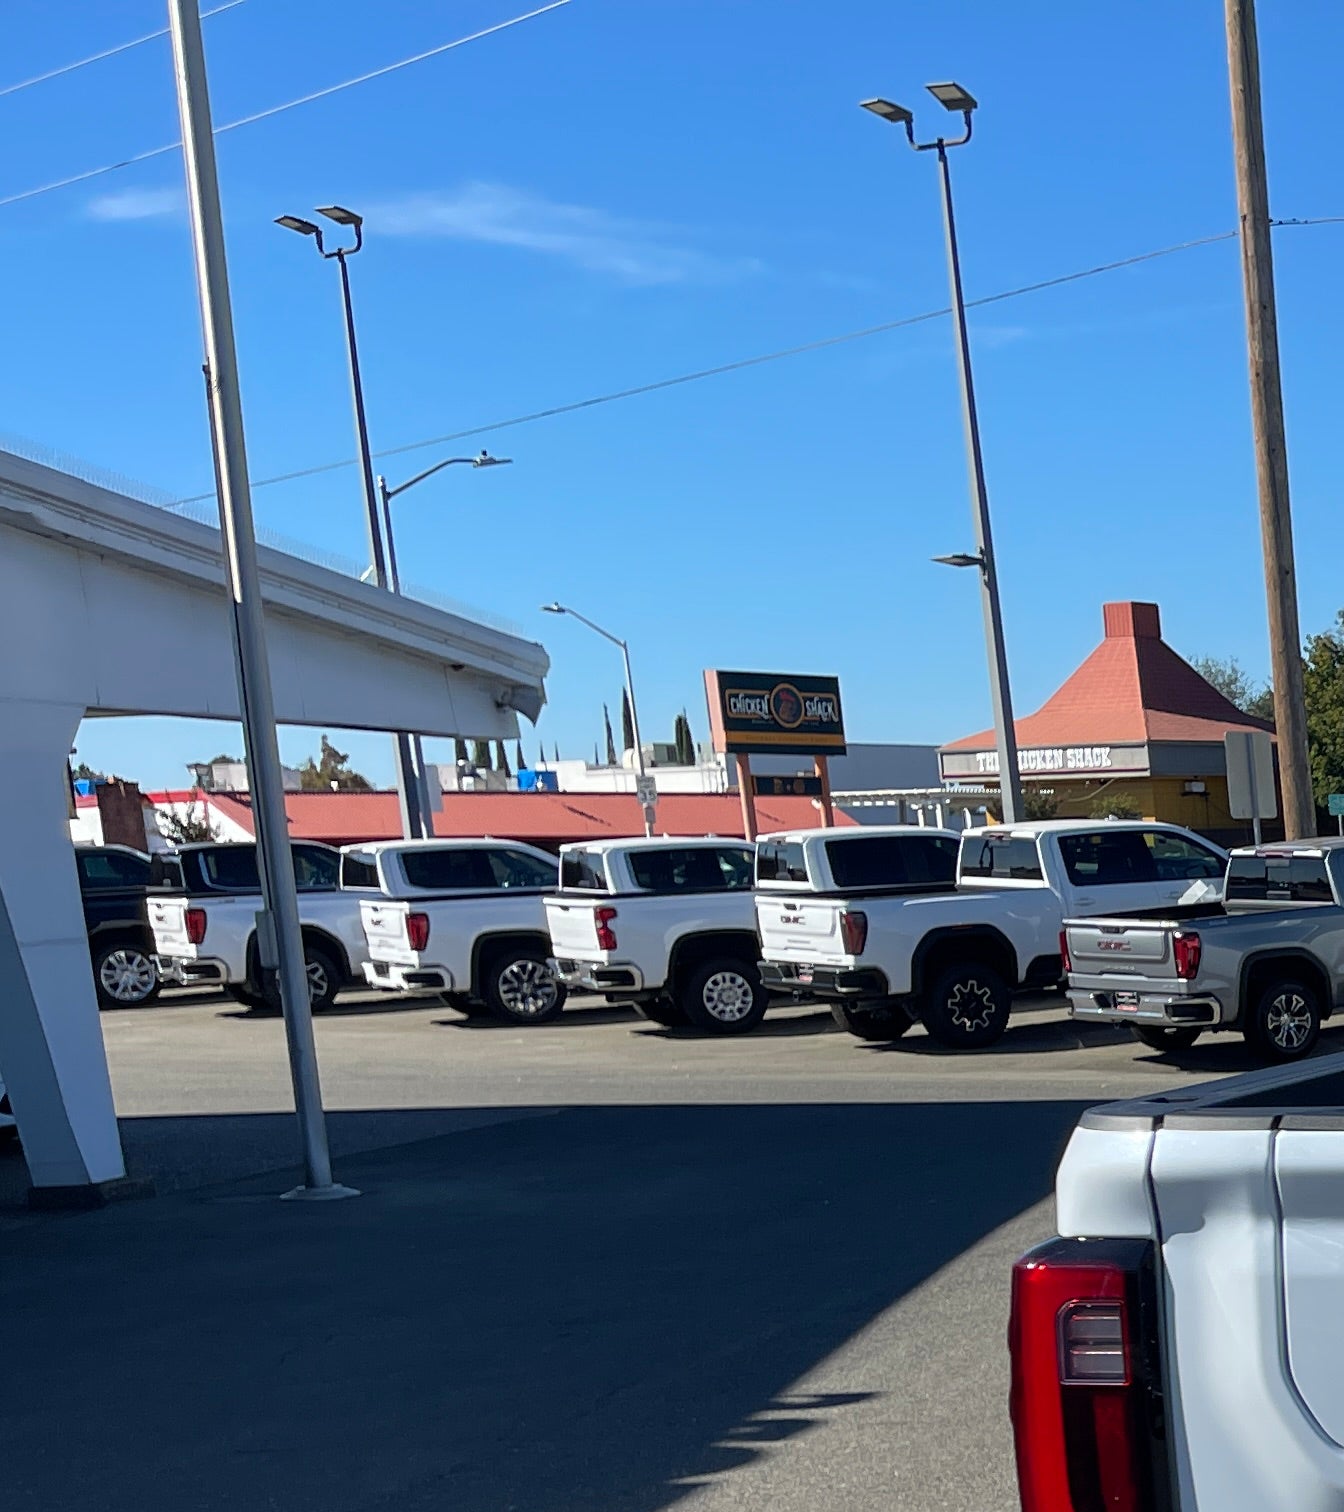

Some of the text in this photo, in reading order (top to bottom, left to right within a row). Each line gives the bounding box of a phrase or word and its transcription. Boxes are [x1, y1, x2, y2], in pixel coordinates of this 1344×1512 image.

[730, 693, 839, 722] CHICKEN SHACK
[1067, 747, 1112, 768] SHACK
